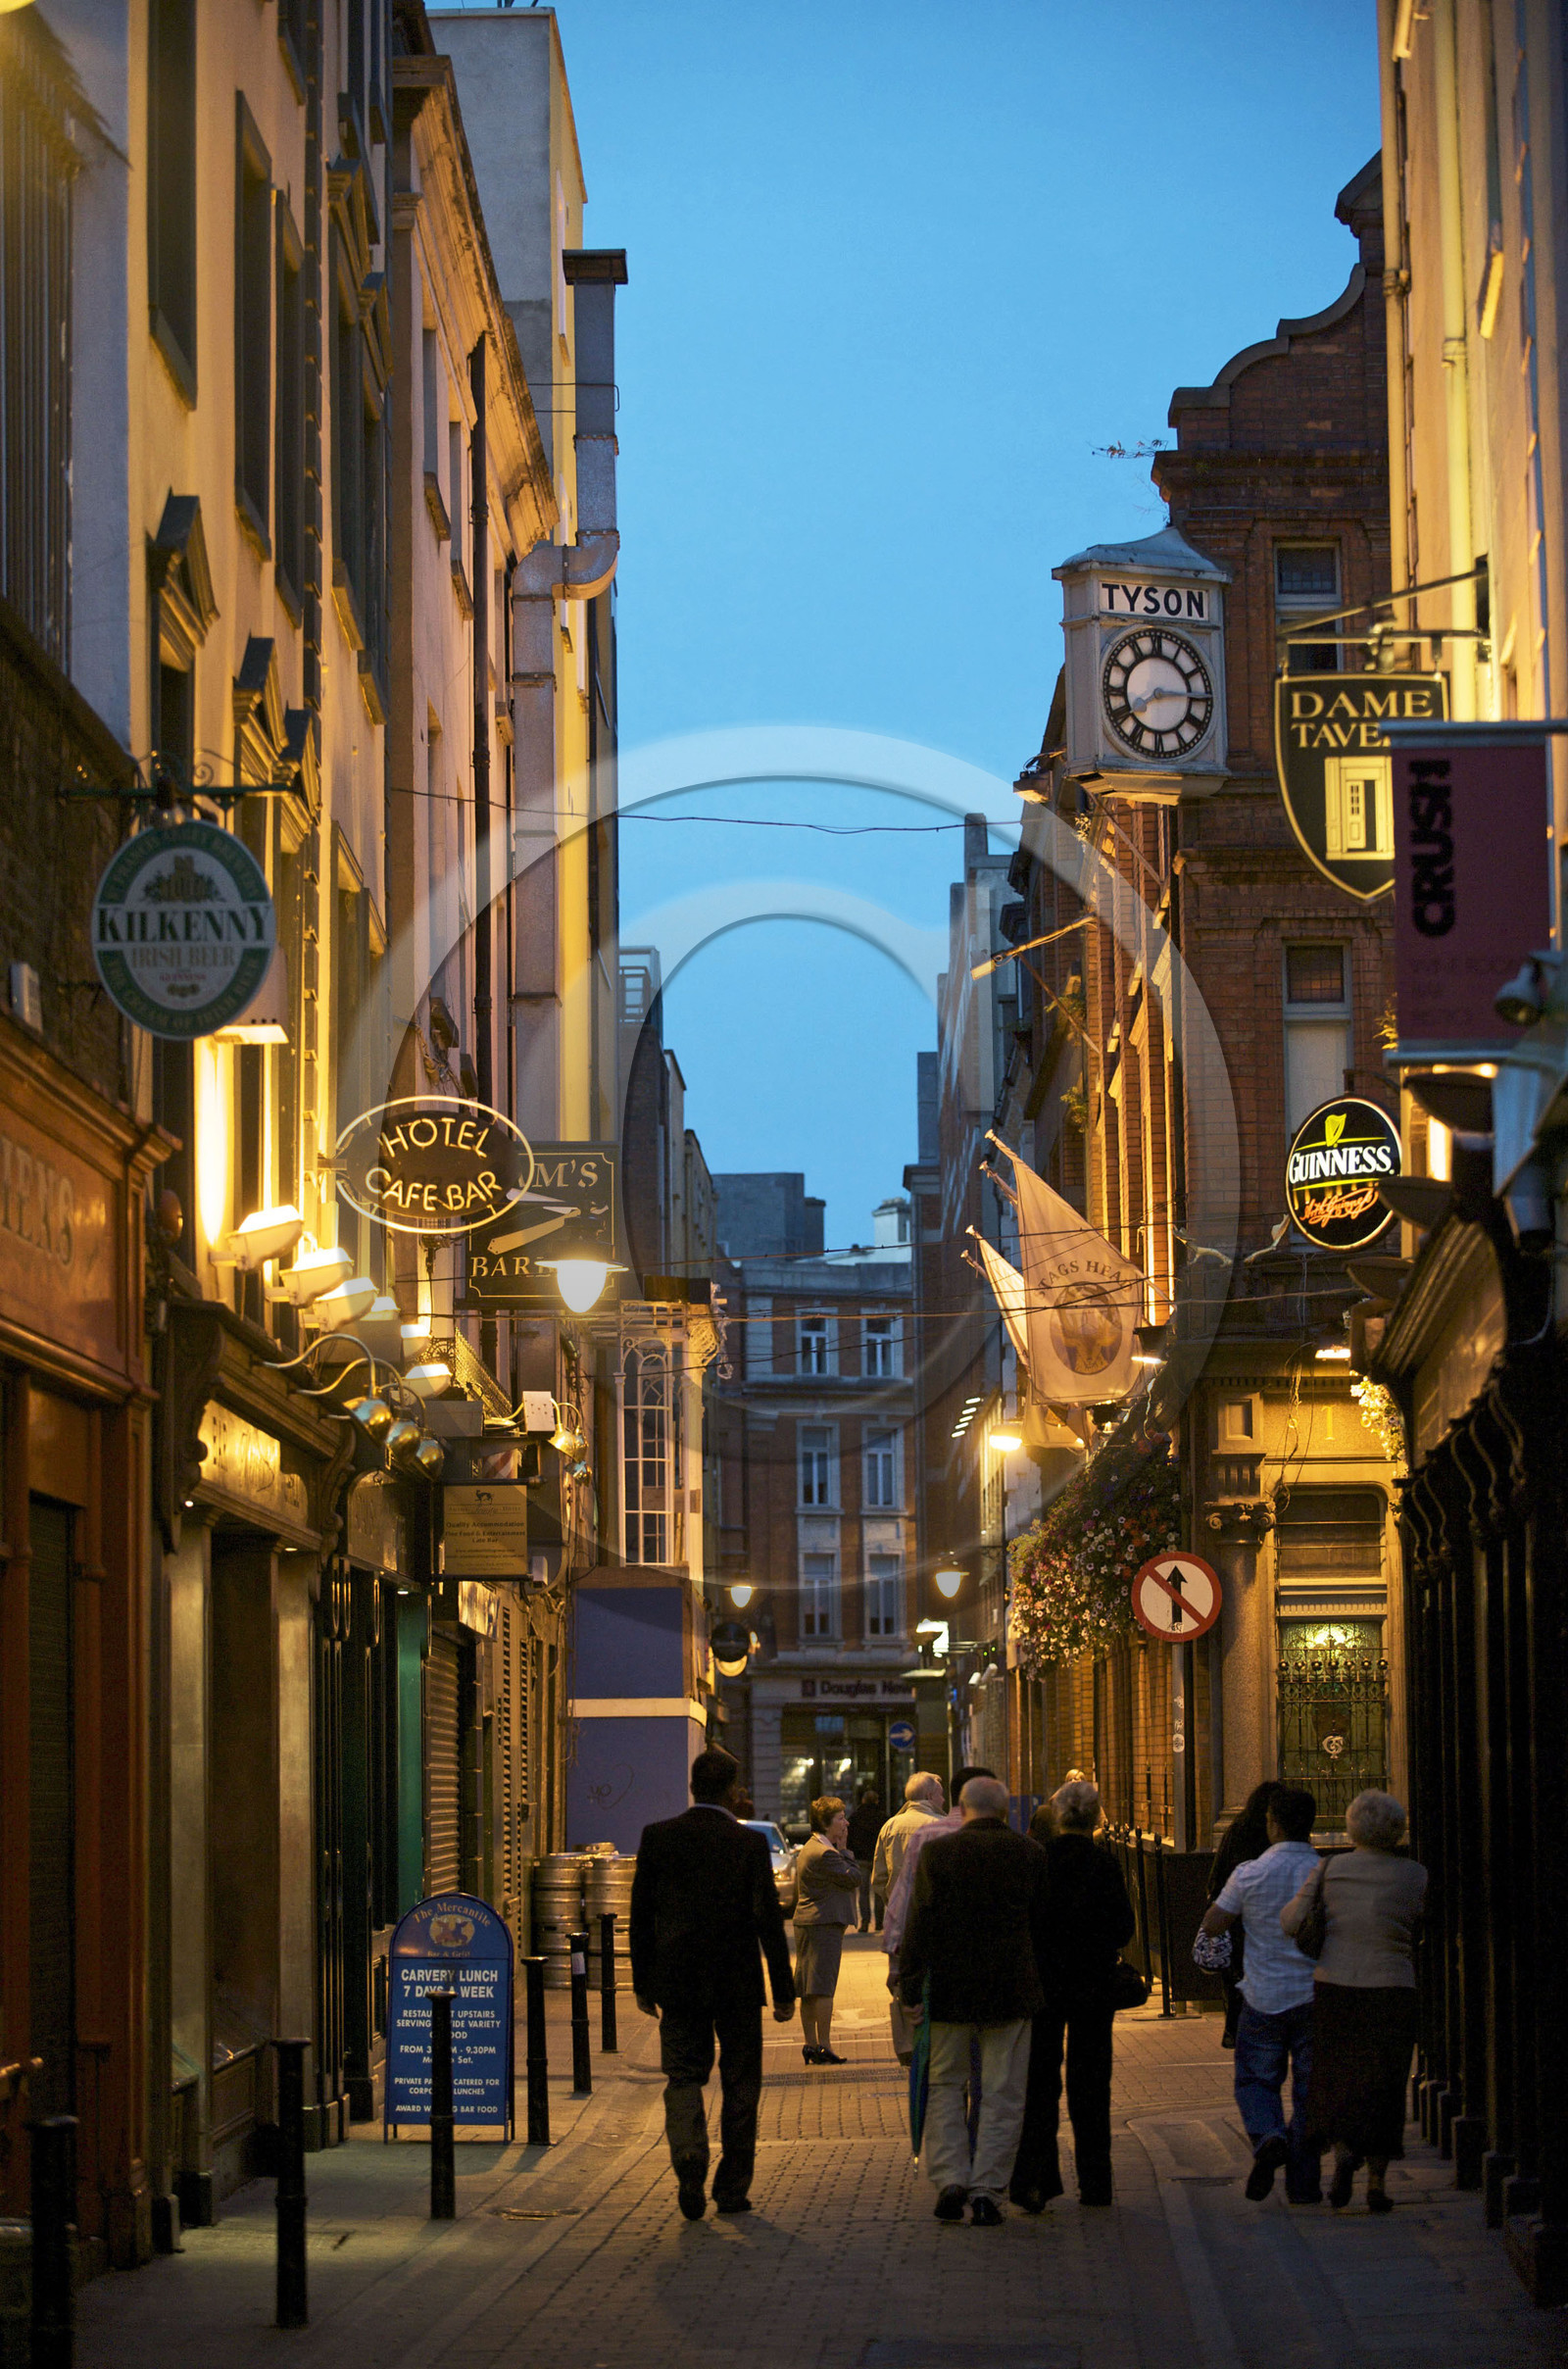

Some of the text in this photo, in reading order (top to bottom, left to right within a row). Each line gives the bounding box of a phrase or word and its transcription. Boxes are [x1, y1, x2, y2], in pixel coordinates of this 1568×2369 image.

[1102, 583, 1204, 618] TYSON
[1292, 690, 1433, 717] DAME
[1291, 721, 1392, 748] TAVE
[1409, 759, 1455, 937] CRUSH
[99, 906, 271, 942] KILKENNY
[132, 945, 235, 967] IRISH BEER
[380, 1117, 489, 1158] HOTEL
[1289, 1146, 1392, 1184] GUINNESS
[366, 1167, 503, 1211] CAFE BAR
[414, 1902, 491, 1927] The Mercantile
[401, 1969, 498, 1982] CARVERY LUNCH
[404, 1985, 411, 1998] 7
[460, 1986, 494, 1998] WEEK
[403, 2009, 455, 2018] RESTAUT
[400, 2045, 423, 2053] FROM
[466, 2046, 496, 2054] 9.30PM
[458, 2055, 473, 2064] Sat.
